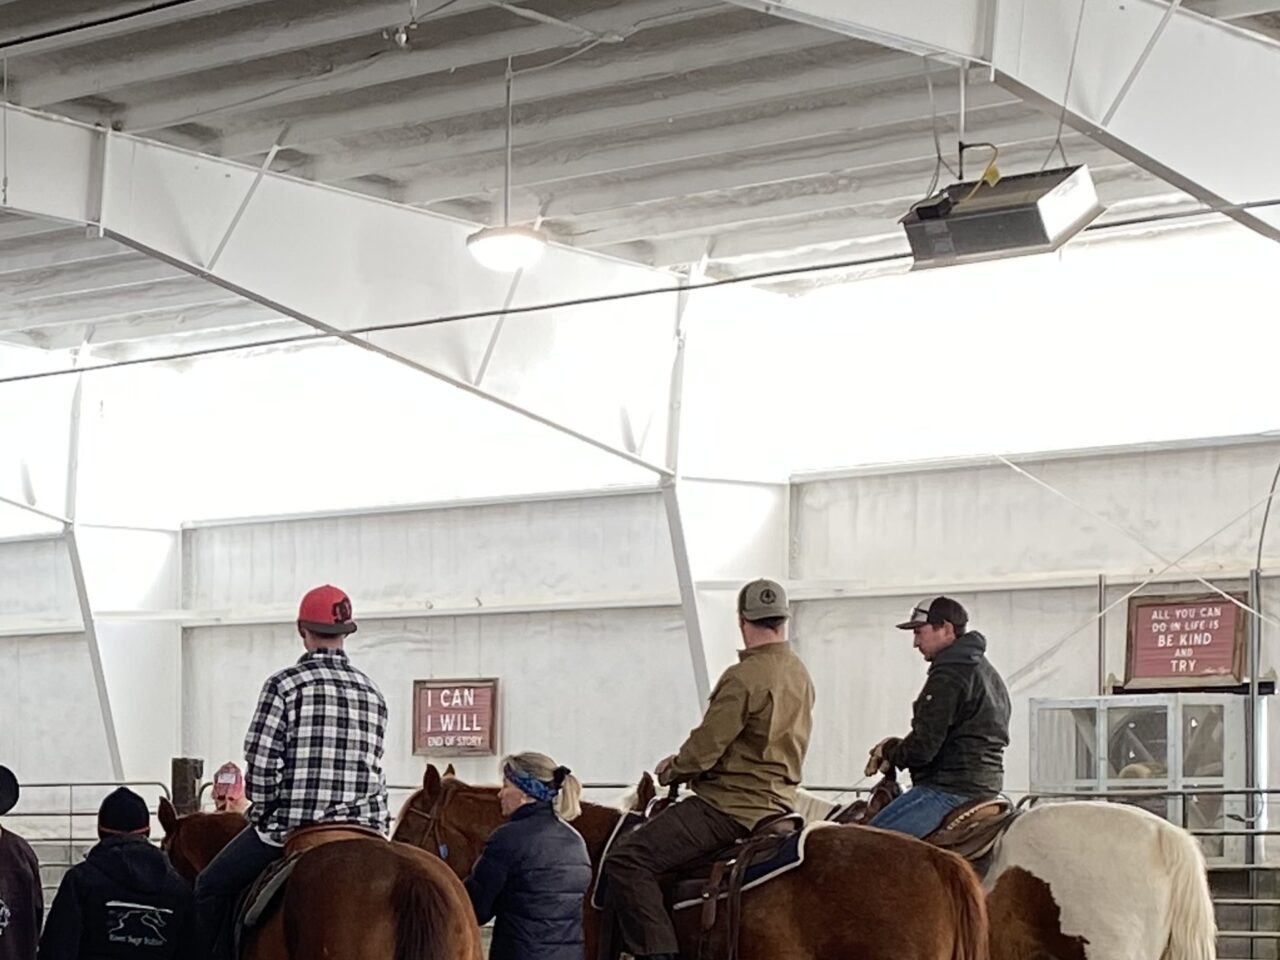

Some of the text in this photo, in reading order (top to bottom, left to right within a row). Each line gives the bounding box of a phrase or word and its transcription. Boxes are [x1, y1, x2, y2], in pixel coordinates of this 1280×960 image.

[1151, 607, 1221, 620] ALL YOU CAN
[1152, 619, 1219, 633] DO IN LIFE IS
[1157, 632, 1212, 647] BE KIND
[1174, 648, 1193, 657] AND
[1170, 659, 1196, 672] TRY
[427, 688, 474, 707] I CAN
[426, 713, 481, 732] I WILL
[427, 735, 482, 747] END OF STORY
